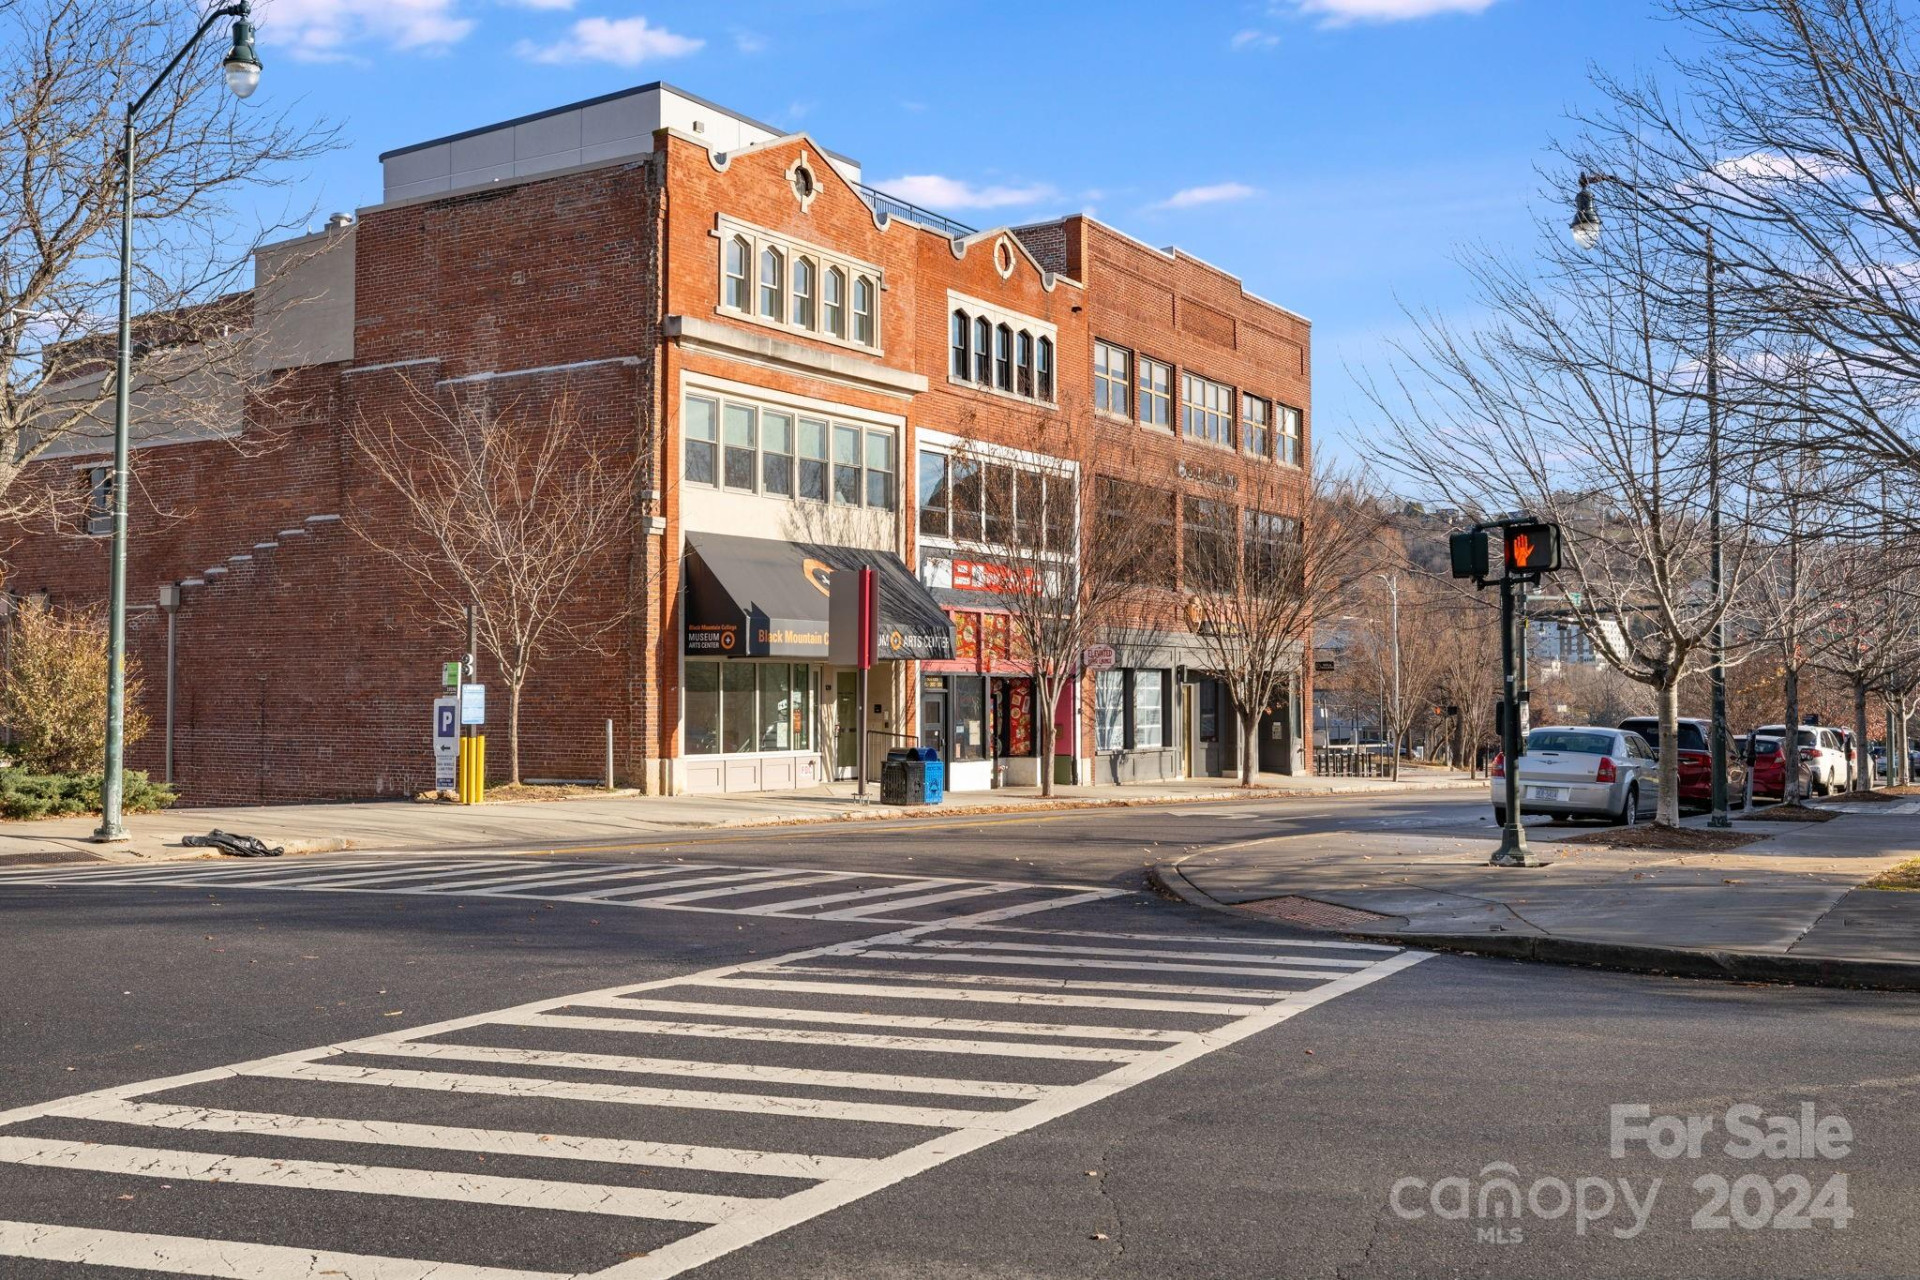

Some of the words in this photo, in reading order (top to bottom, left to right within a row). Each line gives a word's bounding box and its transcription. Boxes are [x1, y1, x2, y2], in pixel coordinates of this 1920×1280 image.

[721, 624, 737, 632] College
[688, 633, 720, 641] MUSEUM
[758, 629, 783, 643] Black
[784, 630, 822, 645] Mountain
[903, 636, 922, 648] ARTS
[924, 637, 950, 649] CENTER
[1088, 650, 1112, 658] ELEVATED
[442, 711, 453, 731] P
